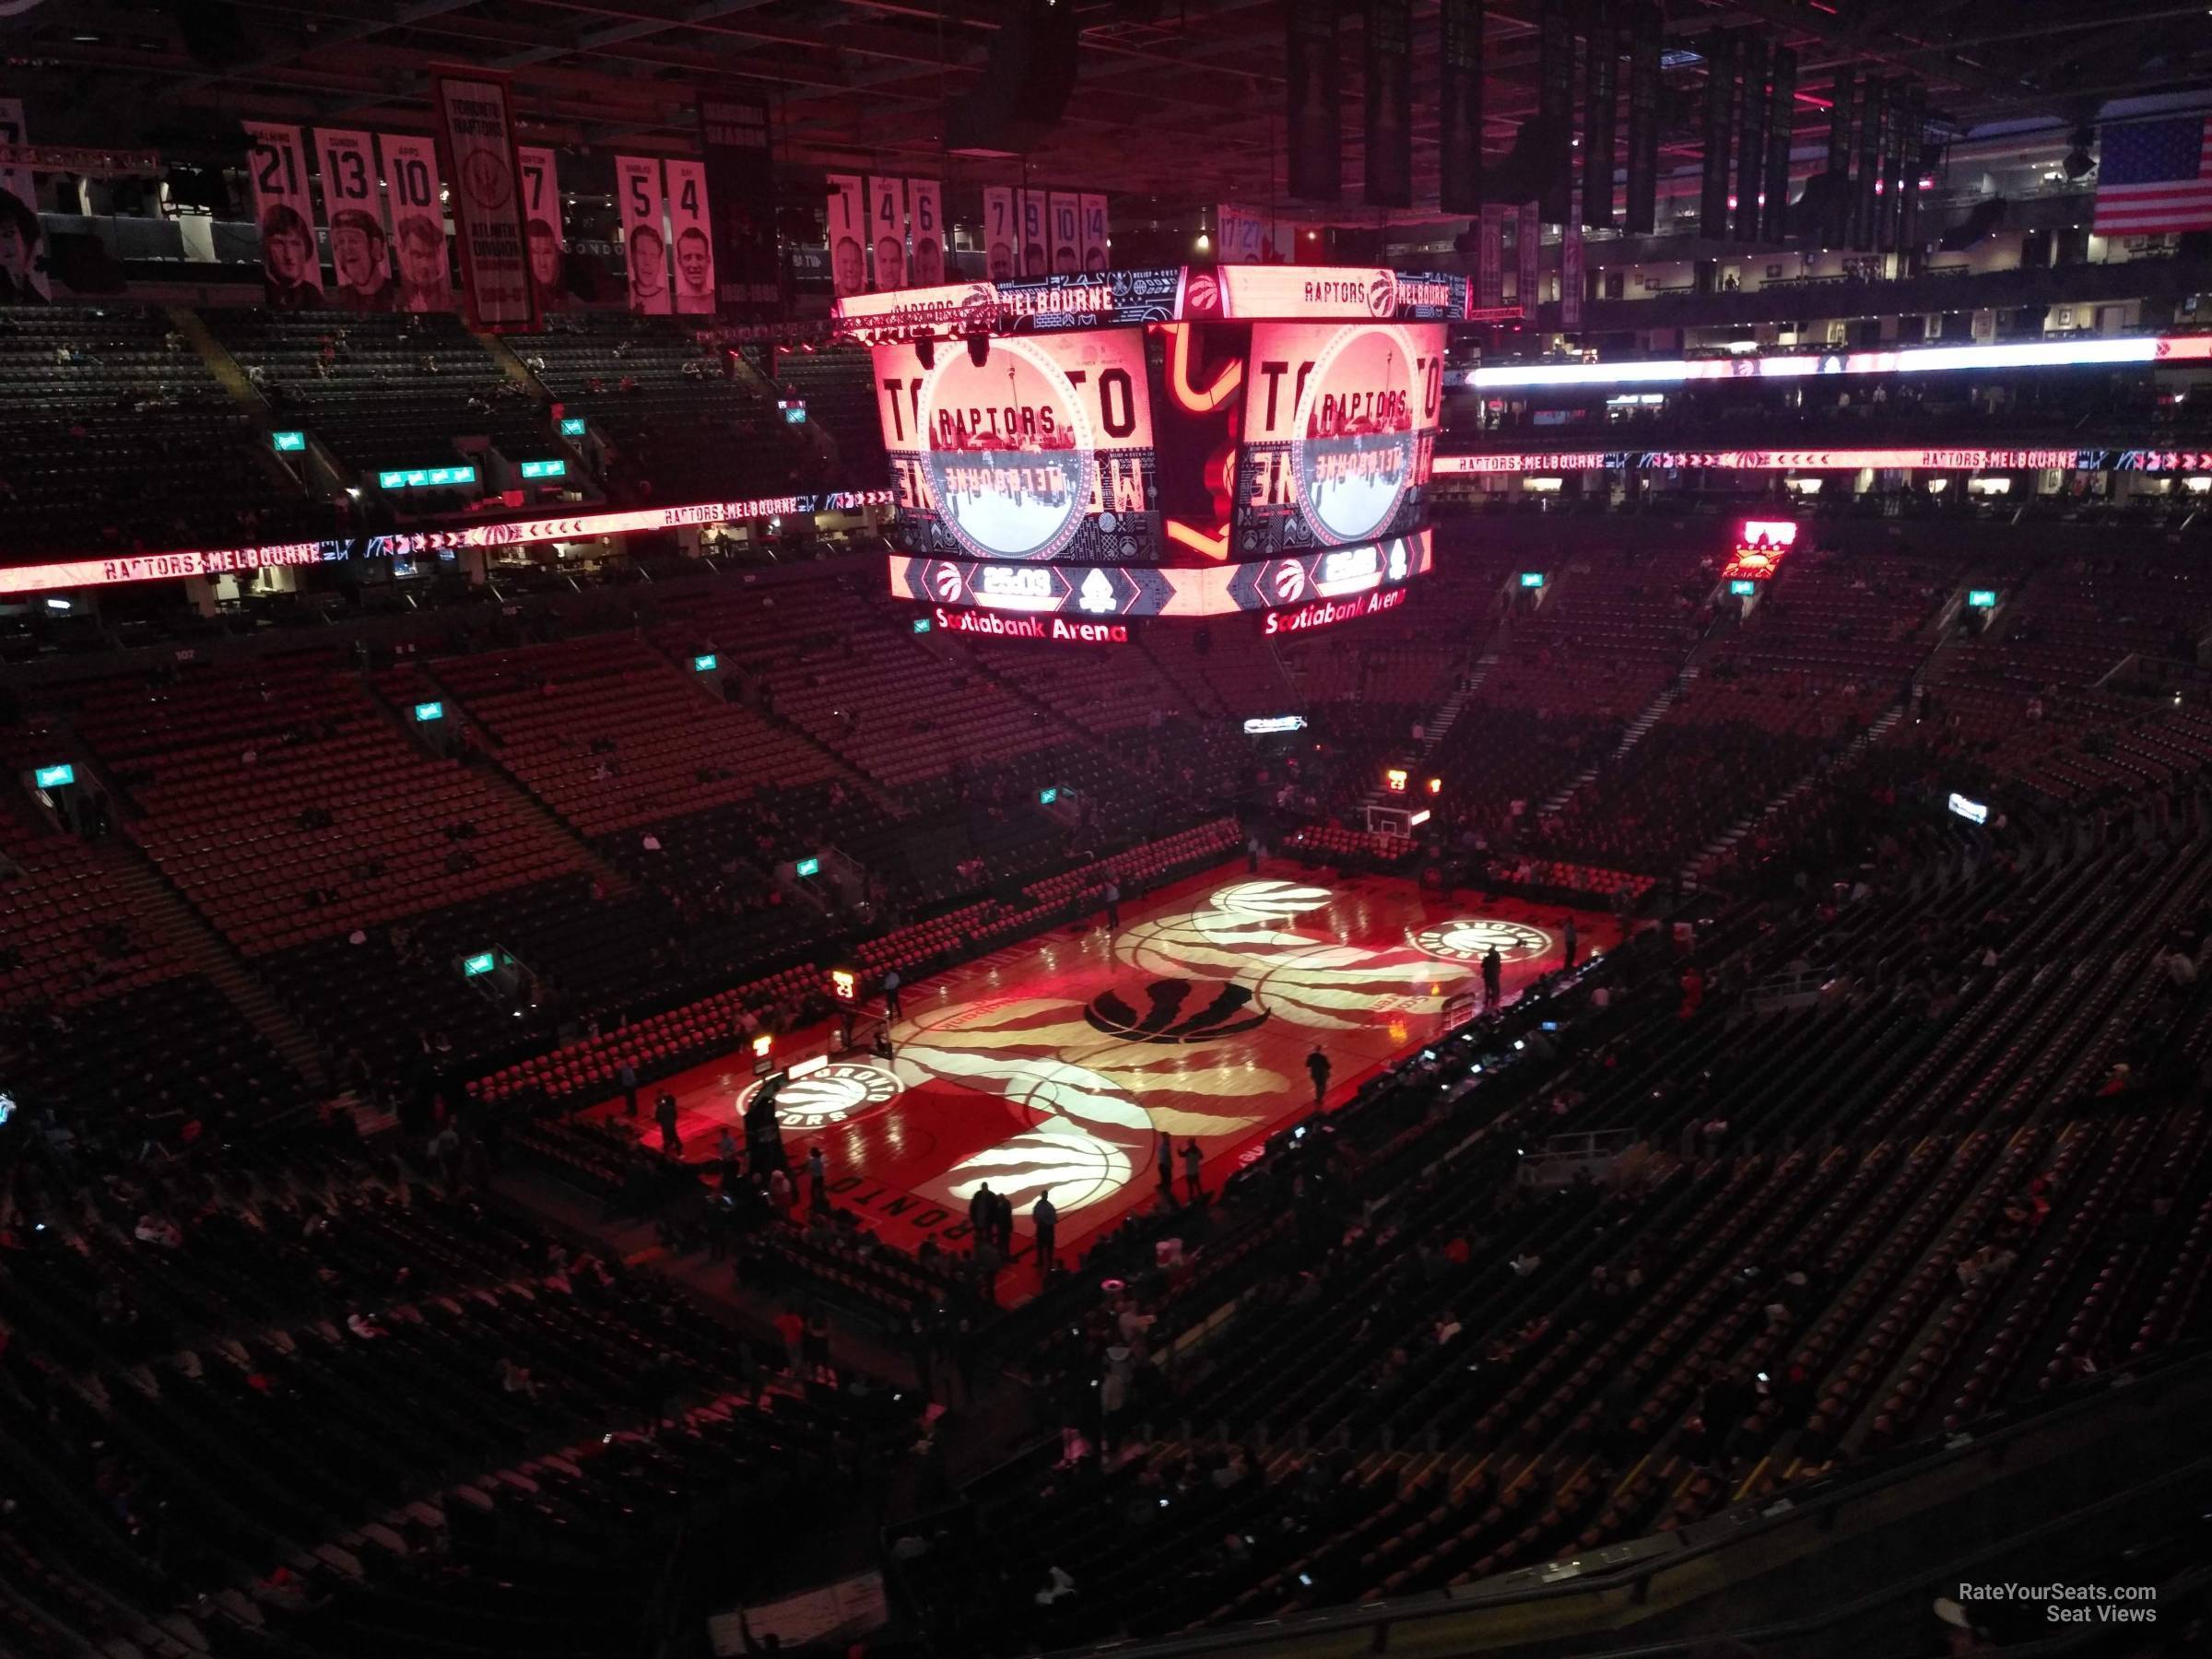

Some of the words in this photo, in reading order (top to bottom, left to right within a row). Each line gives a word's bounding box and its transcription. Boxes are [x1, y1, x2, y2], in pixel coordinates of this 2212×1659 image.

[251, 145, 298, 194] 21
[328, 149, 368, 199] 13
[394, 159, 431, 206] 10
[524, 167, 543, 210] 7
[631, 175, 651, 218] 5
[681, 180, 700, 219] 4
[842, 193, 851, 229] 1
[880, 194, 894, 229] 4
[920, 195, 933, 231] 6
[992, 202, 1005, 236] 7
[1027, 204, 1039, 237] 9
[1059, 208, 1075, 241] 10
[1087, 208, 1103, 241] 14
[1221, 218, 1234, 246] 17
[1244, 220, 1260, 249] 27
[1305, 280, 1365, 303] RAPTORS
[1396, 280, 1452, 306] MELBOURNE
[938, 406, 1055, 439] RAPTORS
[1322, 389, 1407, 423] RAPTORS
[1524, 453, 1605, 471] MELBOURNE
[1990, 449, 2077, 469] MELBOURNE
[727, 497, 798, 520] MELBOURNE
[208, 542, 322, 571] MELBOURNE
[935, 607, 1047, 639] Scotiabank
[1053, 619, 1128, 643] Arena
[1265, 595, 1366, 635] Scotiabank
[1368, 587, 1406, 614] Arena
